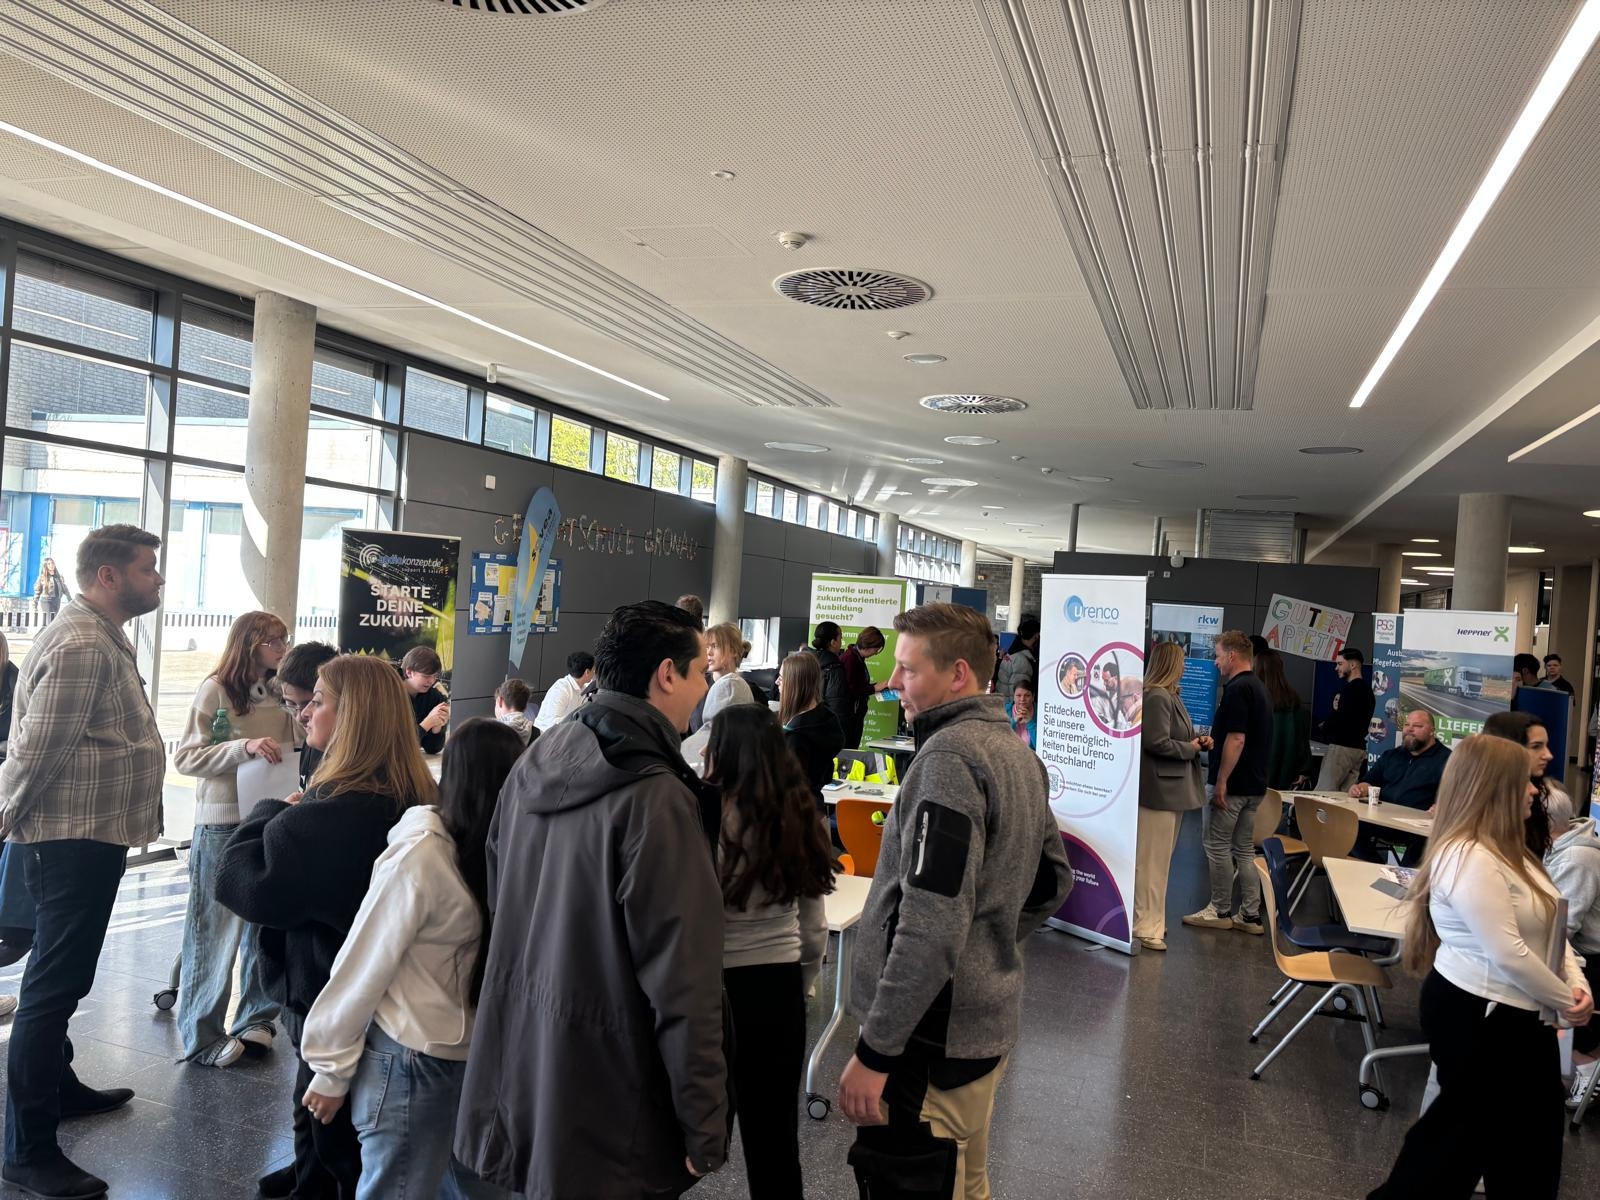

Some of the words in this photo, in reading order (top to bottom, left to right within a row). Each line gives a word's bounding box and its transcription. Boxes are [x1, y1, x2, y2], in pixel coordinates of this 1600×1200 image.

[370, 584, 431, 600] STARTE
[817, 584, 856, 594] Sinnvolle
[858, 587, 875, 595] und
[376, 599, 425, 614] DEINE
[816, 593, 898, 606] zukunftsorientierte
[815, 603, 863, 614] Ausbildung
[815, 612, 854, 621] gesucht?
[359, 613, 440, 630] ZUKUNFT!
[1197, 614, 1219, 625] rkw
[1272, 599, 1352, 637] GUTEN
[1265, 624, 1345, 661] APPETIT
[1387, 648, 1403, 657] Ausb
[1372, 657, 1402, 668] Pflegefach
[1044, 702, 1086, 719] Entdecken
[1043, 714, 1056, 726] Sie
[1056, 718, 1085, 732] unsere
[1043, 726, 1113, 748] Karrieremöglich-
[1042, 738, 1065, 752] keiten
[1066, 743, 1081, 754] bei
[1082, 745, 1115, 761] Urenco
[1042, 750, 1096, 770] Deutschland!
